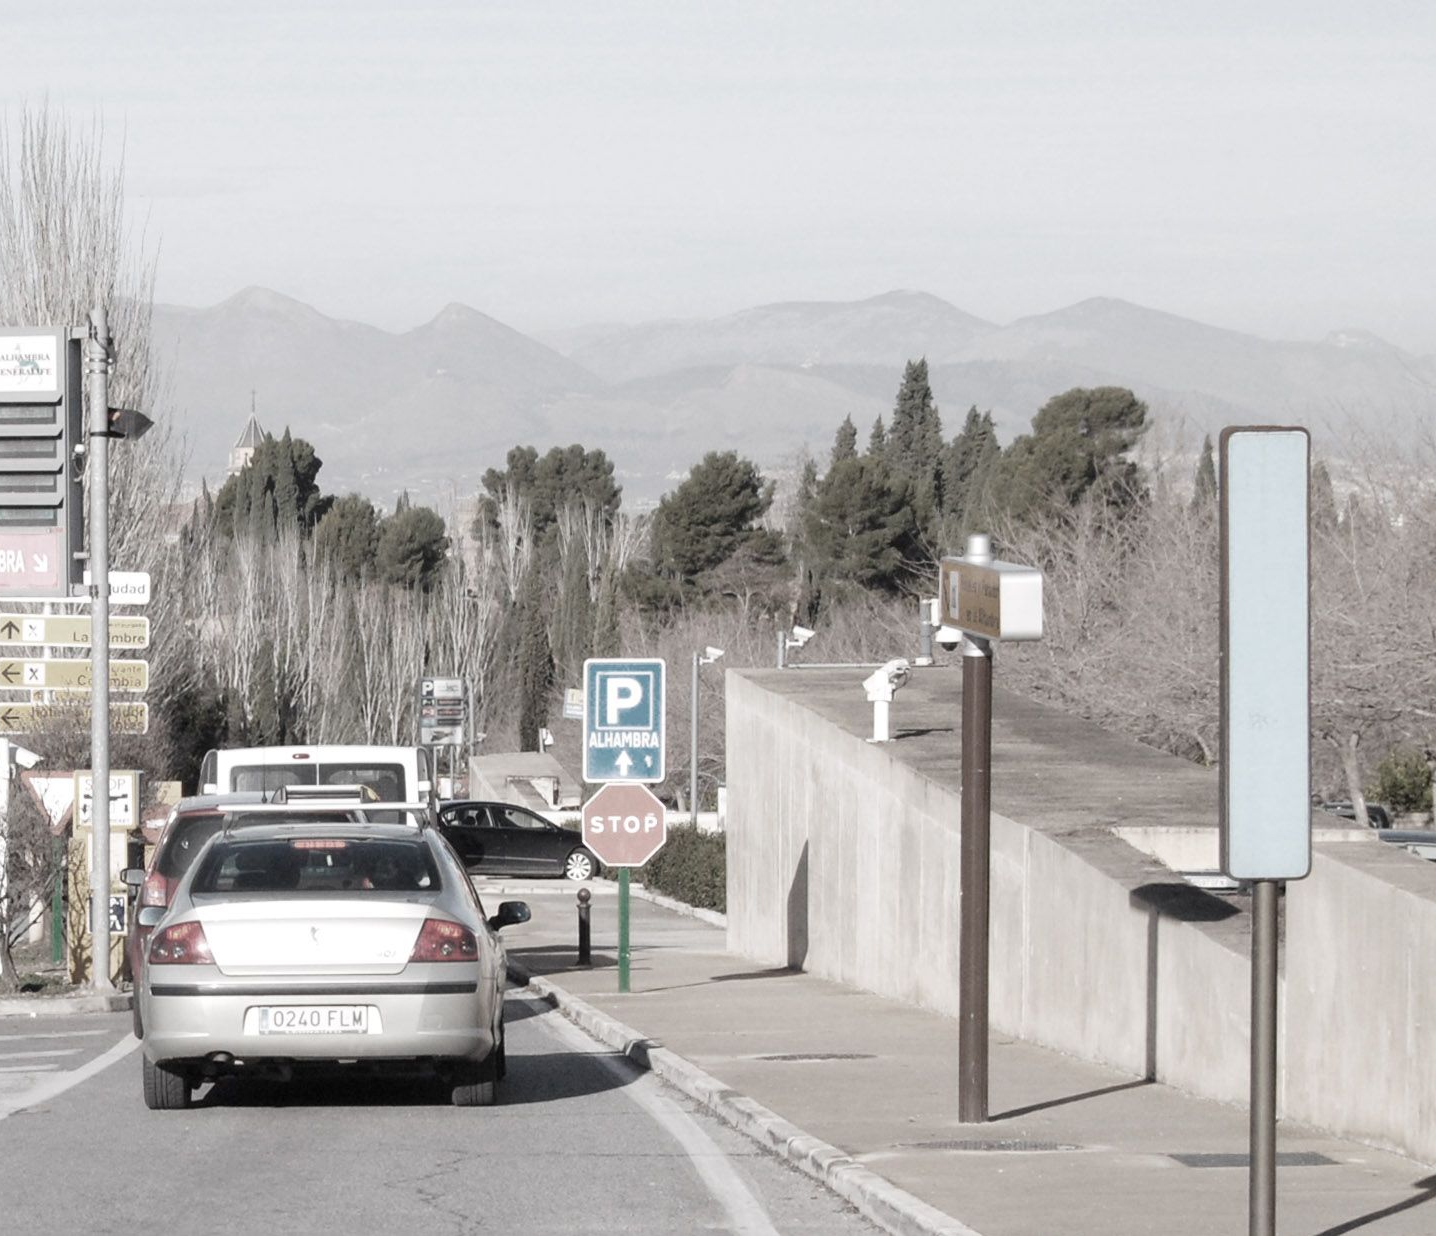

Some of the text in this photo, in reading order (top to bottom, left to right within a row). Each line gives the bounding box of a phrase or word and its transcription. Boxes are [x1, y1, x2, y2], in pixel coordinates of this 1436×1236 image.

[0, 353, 51, 361] ALHAMBRA
[111, 583, 146, 595] udad
[73, 631, 146, 644] La imbre
[422, 681, 434, 697] P
[606, 677, 643, 724] P
[589, 731, 659, 748] ALHAMBRA
[85, 778, 126, 791] SOP
[590, 815, 658, 833] STOP
[273, 1010, 363, 1027] 0240 FLM
